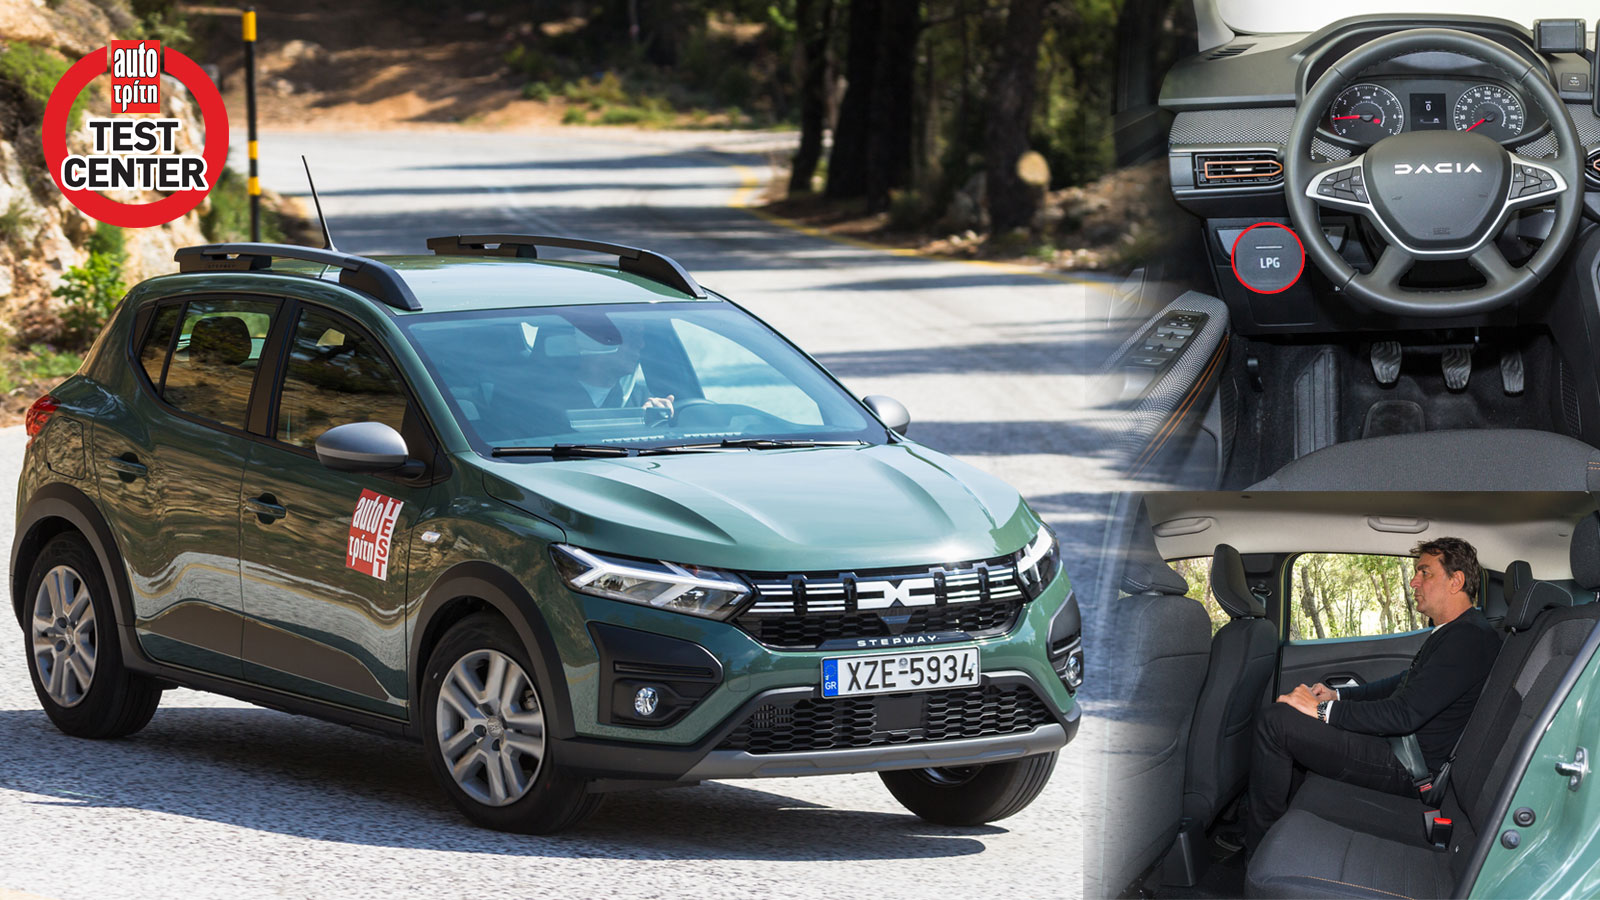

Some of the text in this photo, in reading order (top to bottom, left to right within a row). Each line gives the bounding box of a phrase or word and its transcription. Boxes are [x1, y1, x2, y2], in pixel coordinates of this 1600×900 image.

[1395, 162, 1482, 175] DACIA
[1260, 257, 1280, 268] LPG
[352, 495, 384, 534] auto
[375, 498, 402, 577] TEST
[857, 635, 937, 647] STEPWAY
[847, 653, 974, 692] XZE-5934
[825, 681, 837, 690] GR
